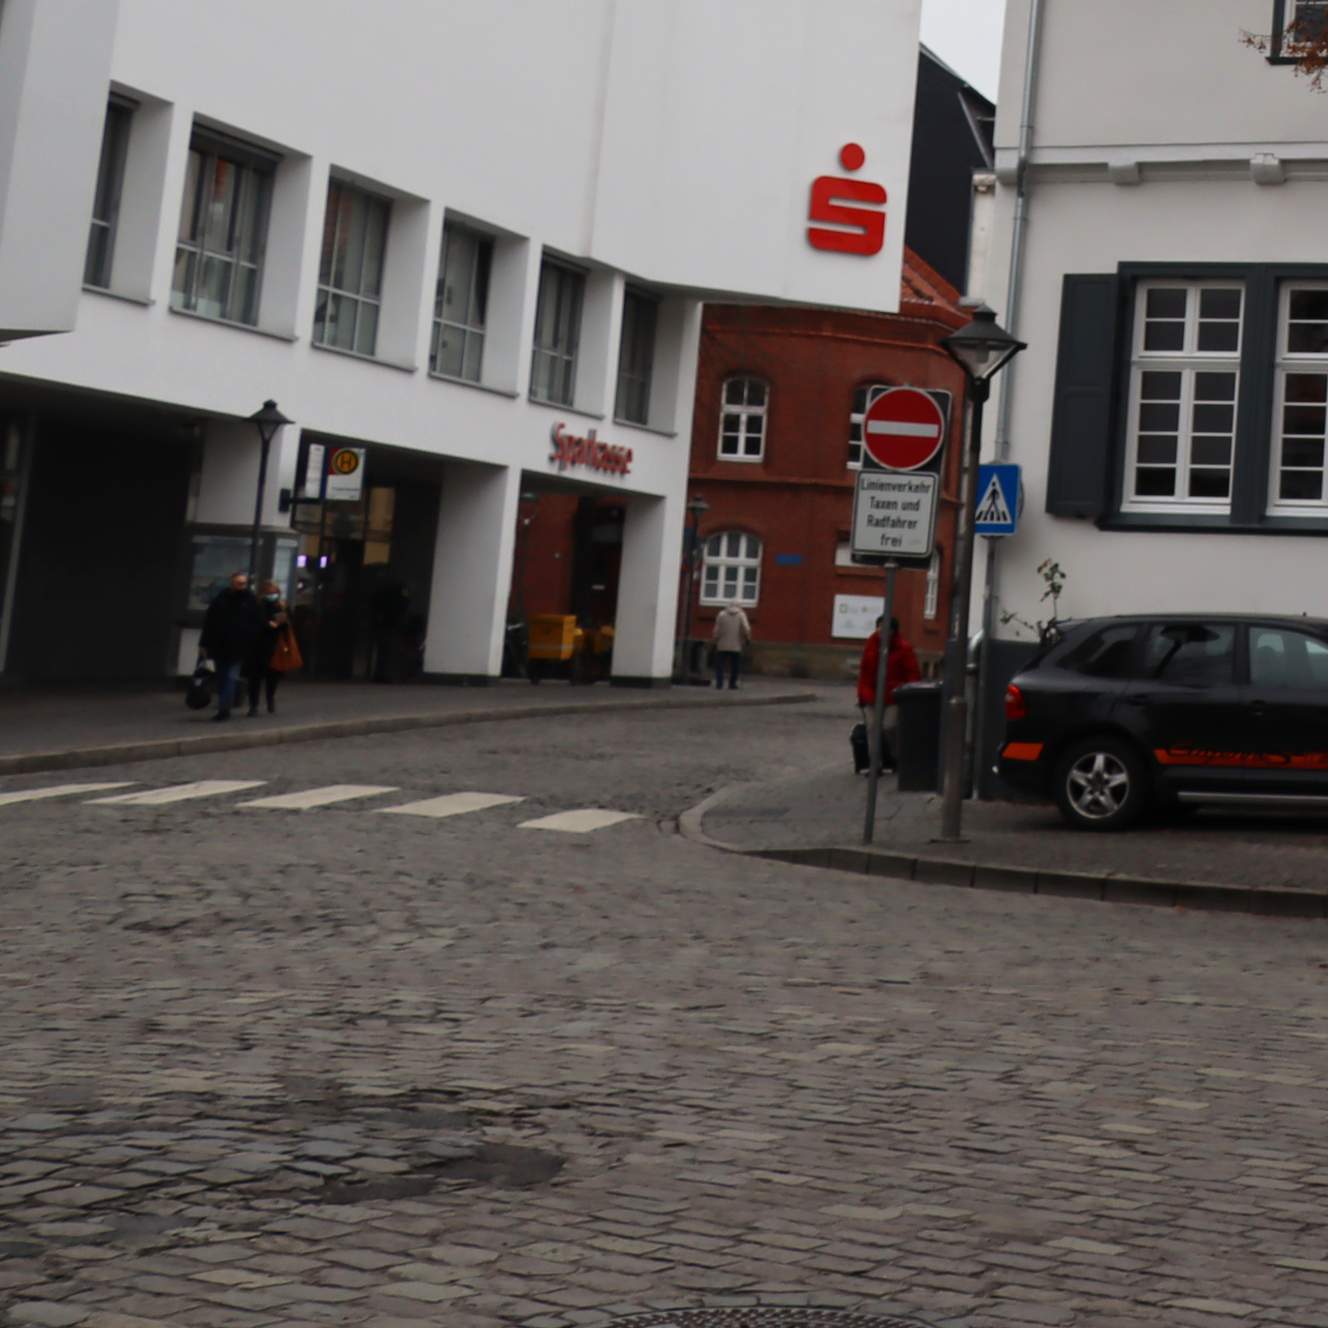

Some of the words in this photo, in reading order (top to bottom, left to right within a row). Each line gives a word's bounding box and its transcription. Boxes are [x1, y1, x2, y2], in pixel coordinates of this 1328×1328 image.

[549, 421, 633, 476] Sparkasse
[860, 477, 931, 493] Linienverkehr
[870, 495, 898, 510] Taxen
[900, 498, 921, 511] und
[867, 513, 918, 529] Radfahrer
[880, 533, 903, 547] frei
